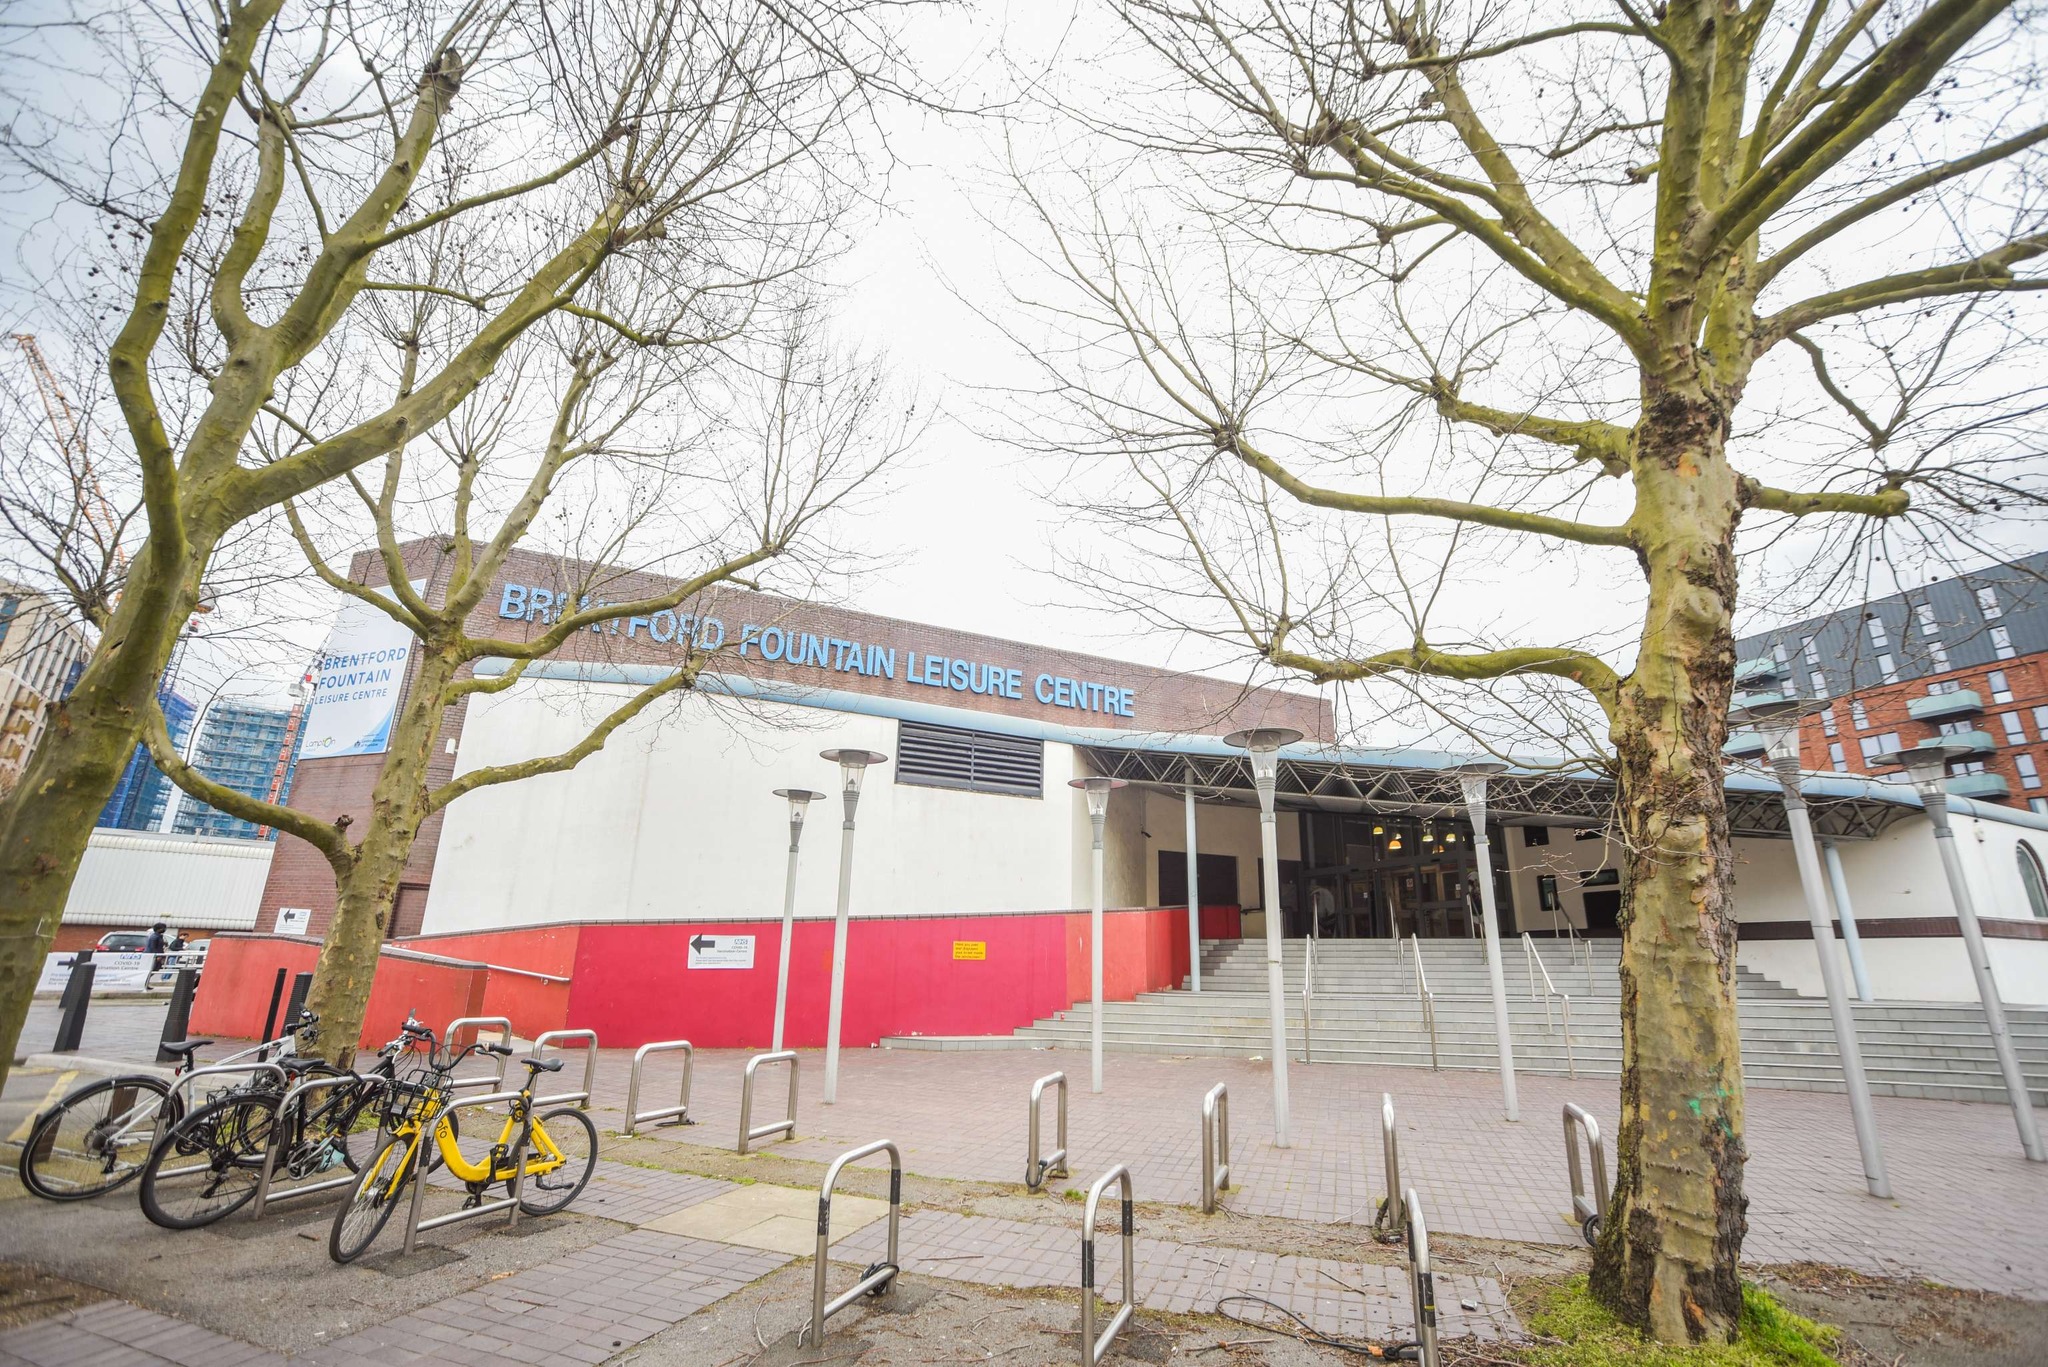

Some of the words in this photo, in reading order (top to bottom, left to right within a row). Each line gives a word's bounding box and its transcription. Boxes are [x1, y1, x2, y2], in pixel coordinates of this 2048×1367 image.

[323, 647, 407, 671] BRENTFORD
[740, 624, 895, 679] FOUNTAIN
[906, 651, 1023, 699] LEISURE
[1034, 673, 1135, 717] CENTRE
[318, 668, 392, 690] FOUNTAIN
[314, 692, 350, 705] LEISURE
[352, 688, 388, 701] CENTRE
